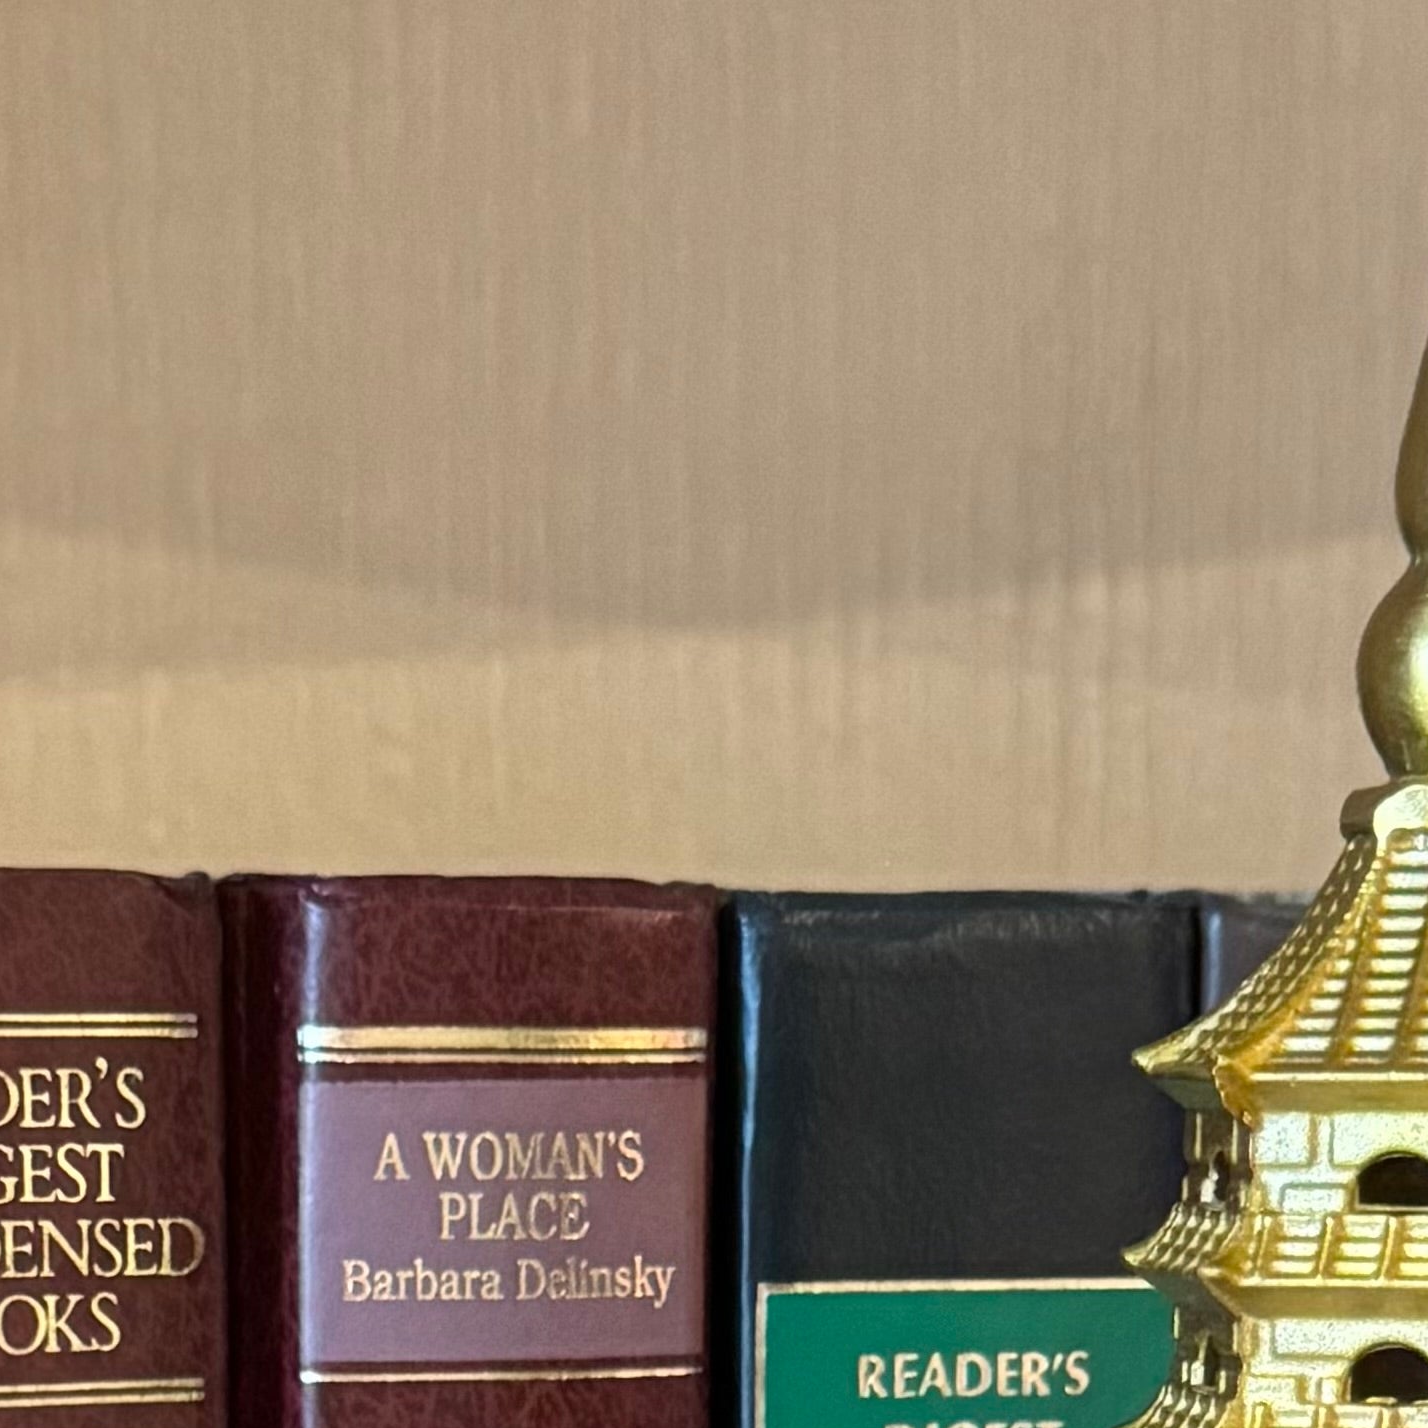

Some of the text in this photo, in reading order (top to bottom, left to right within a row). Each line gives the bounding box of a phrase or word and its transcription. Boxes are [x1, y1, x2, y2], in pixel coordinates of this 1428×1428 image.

[373, 1128, 645, 1183] A WOMAN'S
[439, 1191, 591, 1241] PLACE
[343, 1254, 677, 1308] Barbara Delinsky
[857, 1351, 1091, 1401] READER'S
